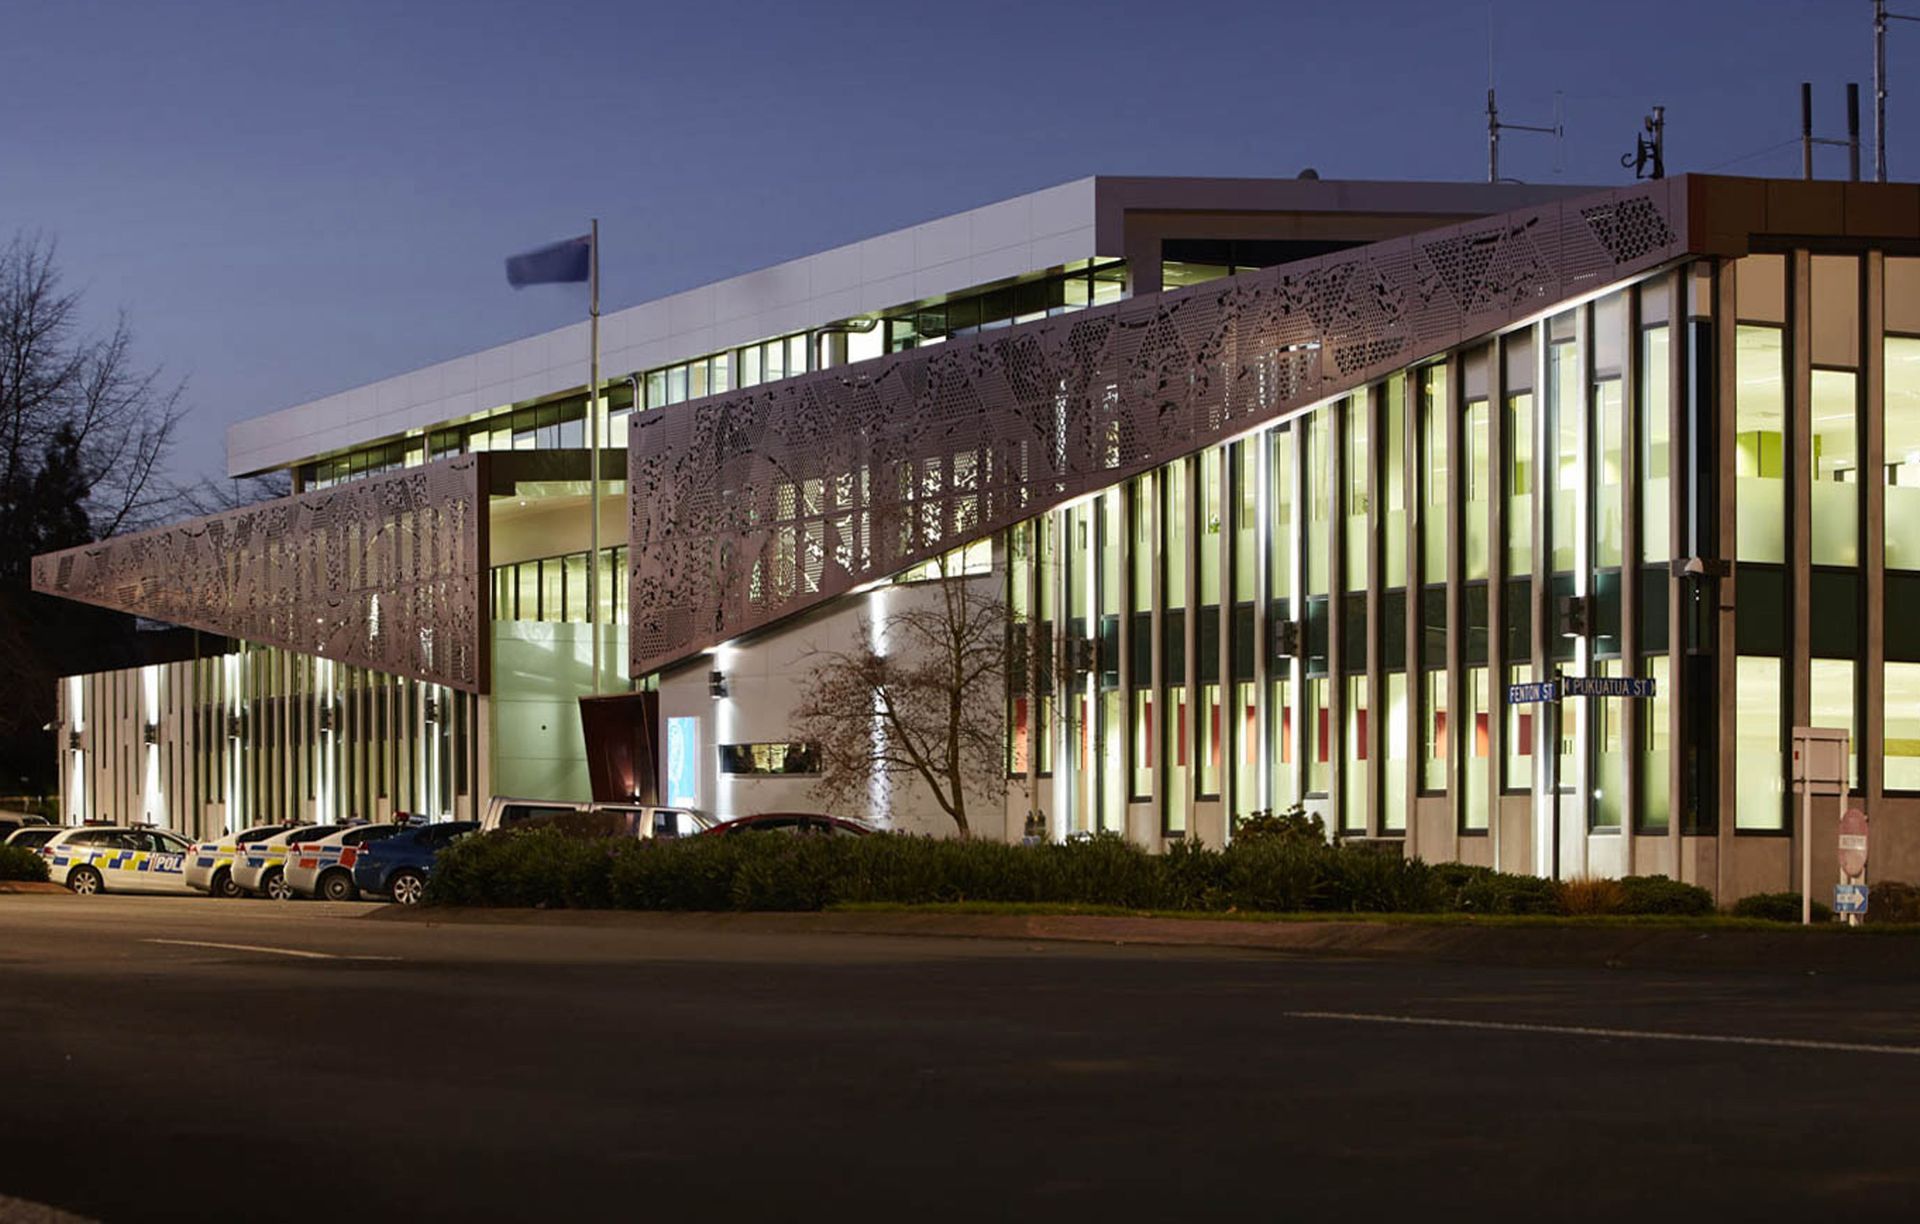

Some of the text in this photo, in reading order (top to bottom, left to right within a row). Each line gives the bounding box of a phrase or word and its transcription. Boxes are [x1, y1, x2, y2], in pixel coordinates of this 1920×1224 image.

[1510, 683, 1553, 702] FENTON ST
[1573, 679, 1647, 695] PUKUATUA ST
